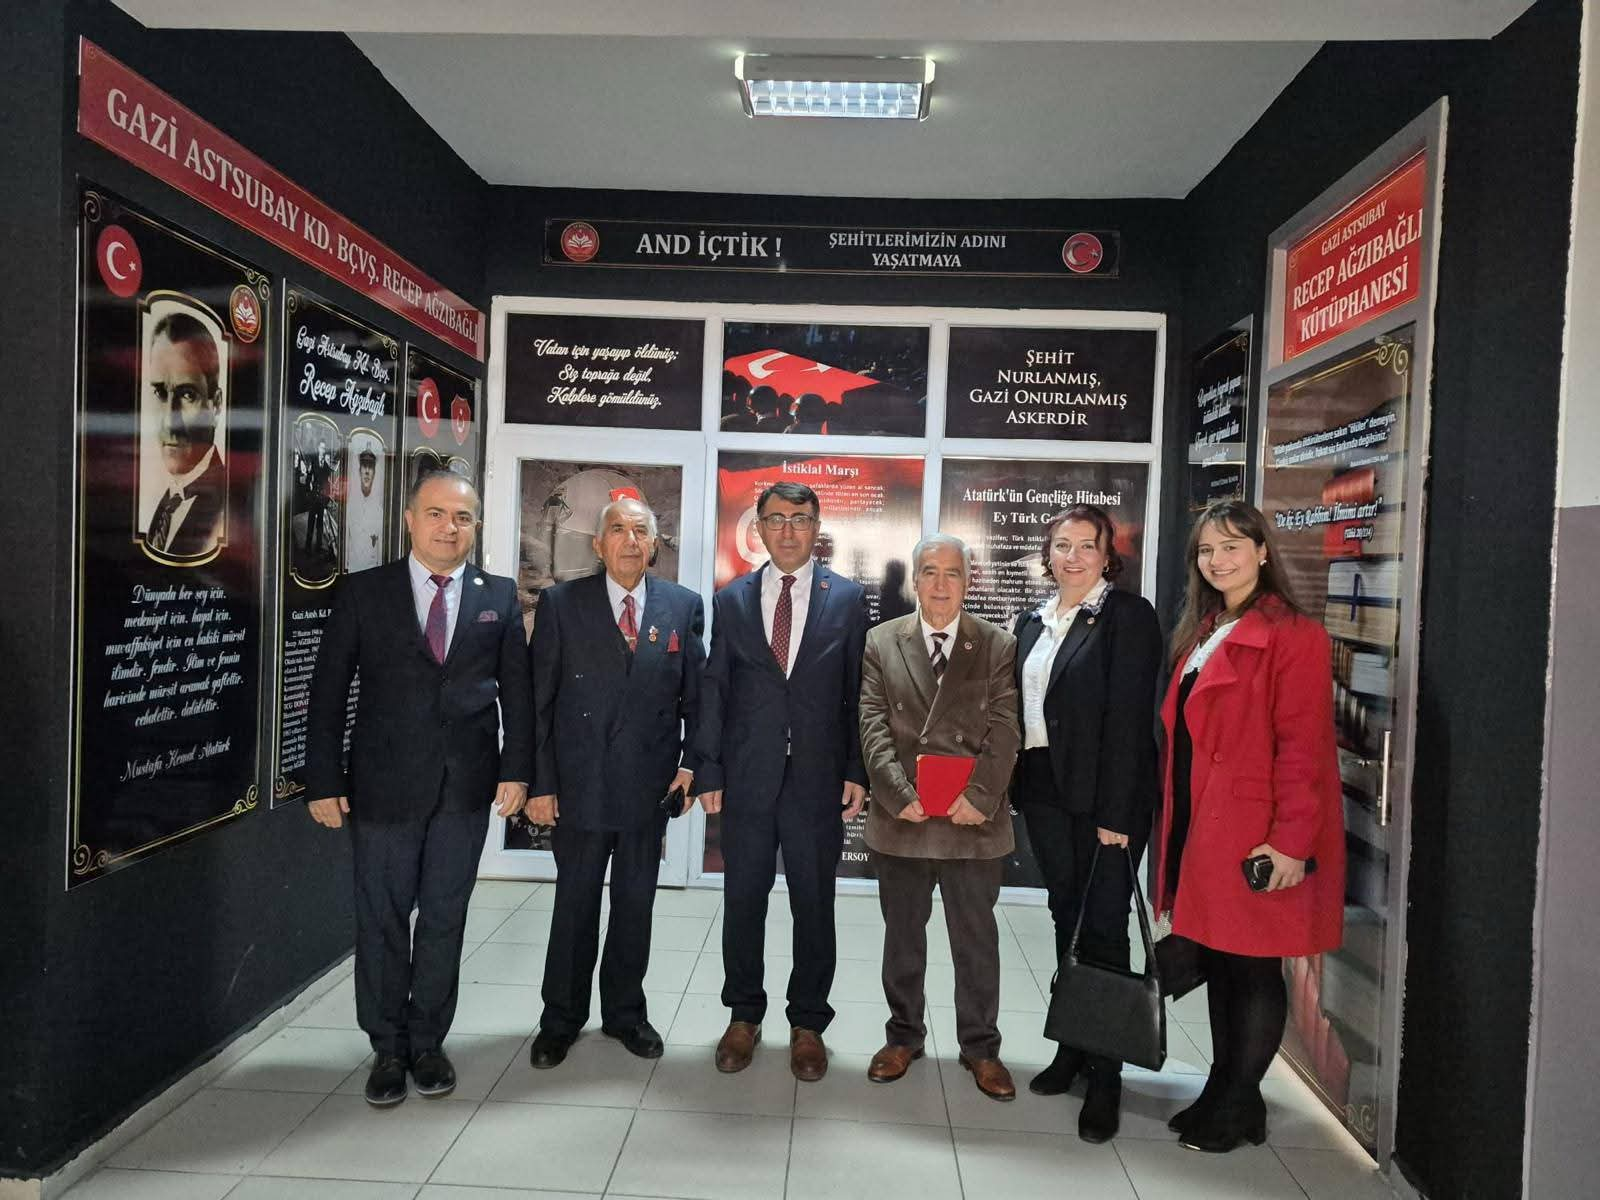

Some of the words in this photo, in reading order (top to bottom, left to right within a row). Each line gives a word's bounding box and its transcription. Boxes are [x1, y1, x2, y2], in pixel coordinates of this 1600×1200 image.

[107, 88, 178, 159] GAZİ
[183, 142, 299, 232] ASTSUBAY
[303, 212, 333, 256] KD.
[337, 240, 379, 285] BÇVŞ.
[382, 270, 423, 307] RECEP
[424, 290, 480, 344] AĞZIBAĞLI
[829, 230, 957, 249] ŞEHİTLERİMİZİN
[960, 235, 1006, 249] ADINI
[1321, 227, 1340, 256] GAZİ
[1340, 200, 1387, 245] ASTSUBAY
[636, 233, 690, 255] AND
[699, 230, 768, 261] İÇTİK
[775, 237, 782, 258] !
[872, 253, 962, 270] YAŞATMAYA
[1293, 265, 1334, 310] RECEP
[1336, 208, 1423, 286] AĞZIBAĞLI
[1301, 256, 1408, 342] KÜTÜPHANESİ
[297, 325, 316, 354] Gazi
[317, 334, 352, 369] Astsubay
[534, 338, 568, 356] Vatan
[572, 345, 590, 360] için
[591, 347, 631, 361] yaşayıp
[634, 344, 679, 363] öldünüz;
[1026, 349, 1075, 367] ŞEHİT
[558, 364, 578, 383] Siz
[581, 367, 620, 384] toprağa
[998, 369, 1101, 390] NURLANMIŞ,
[300, 362, 337, 405] Recep
[340, 378, 386, 421] Ağzıbağlı
[547, 386, 597, 405] Kalplere
[598, 389, 662, 410] gömüldünüz.
[969, 388, 1009, 404] GAZİ
[1015, 390, 1128, 410] ONURLANMIŞ
[1006, 410, 1088, 425] ASKERDİR
[782, 460, 822, 475] İstiklal
[825, 464, 859, 478] Marşı
[963, 488, 1023, 503] Atatürk'ün
[1026, 488, 1073, 507] Gençliğe
[1075, 490, 1121, 506] Hitabesi
[993, 512, 1007, 526] Ey
[1010, 512, 1038, 523] Türk
[131, 584, 176, 609] Dünyada
[178, 583, 193, 600] her
[124, 609, 169, 634] medeniyet
[191, 607, 214, 632] hayat
[184, 637, 194, 647] en
[196, 628, 220, 646] hakiki
[207, 657, 216, 667] ve
[103, 684, 147, 708] haricinde
[180, 674, 211, 695] aramak
[120, 755, 163, 782] Mustafa
[165, 744, 198, 770] Kemal
[198, 736, 231, 760] Atatürk
[842, 851, 870, 862] ERSOY
